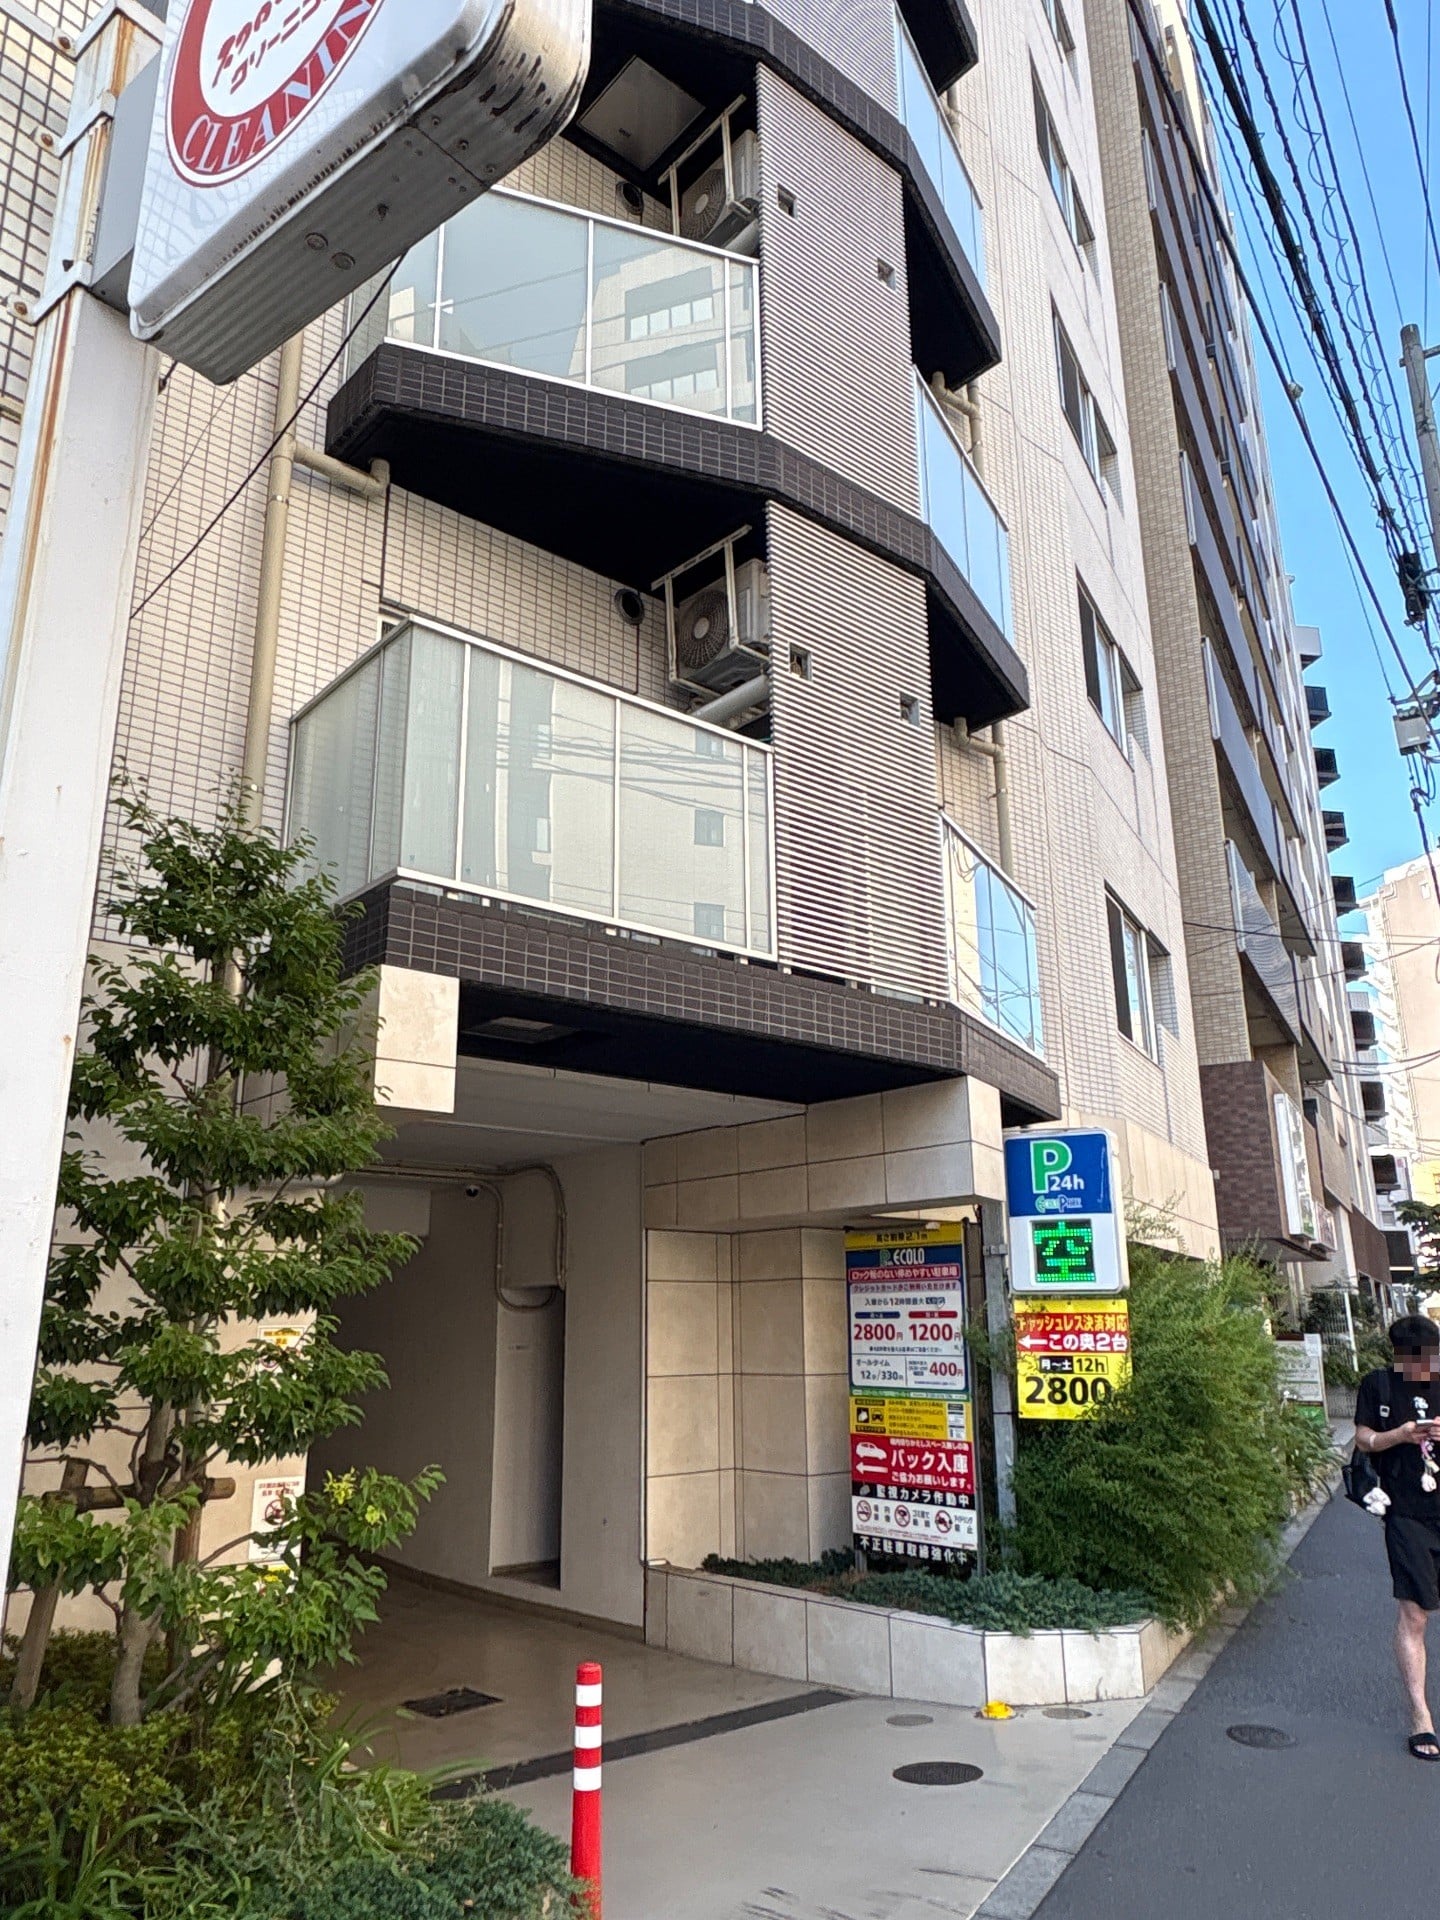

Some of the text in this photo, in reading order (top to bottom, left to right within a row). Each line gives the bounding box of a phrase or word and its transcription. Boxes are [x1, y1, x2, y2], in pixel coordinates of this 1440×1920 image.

[1030, 1140, 1072, 1194] P
[1050, 1174, 1085, 1191] 24h
[893, 1248, 925, 1265] ECOLO
[1034, 1221, 1095, 1281] 空
[1048, 1333, 1127, 1351] この奥2台
[1076, 1358, 1105, 1373] 12h
[1025, 1376, 1112, 1405] 2800
[891, 1450, 968, 1475] バック入庫
[876, 1484, 969, 1507] 監視カメラ作動中
